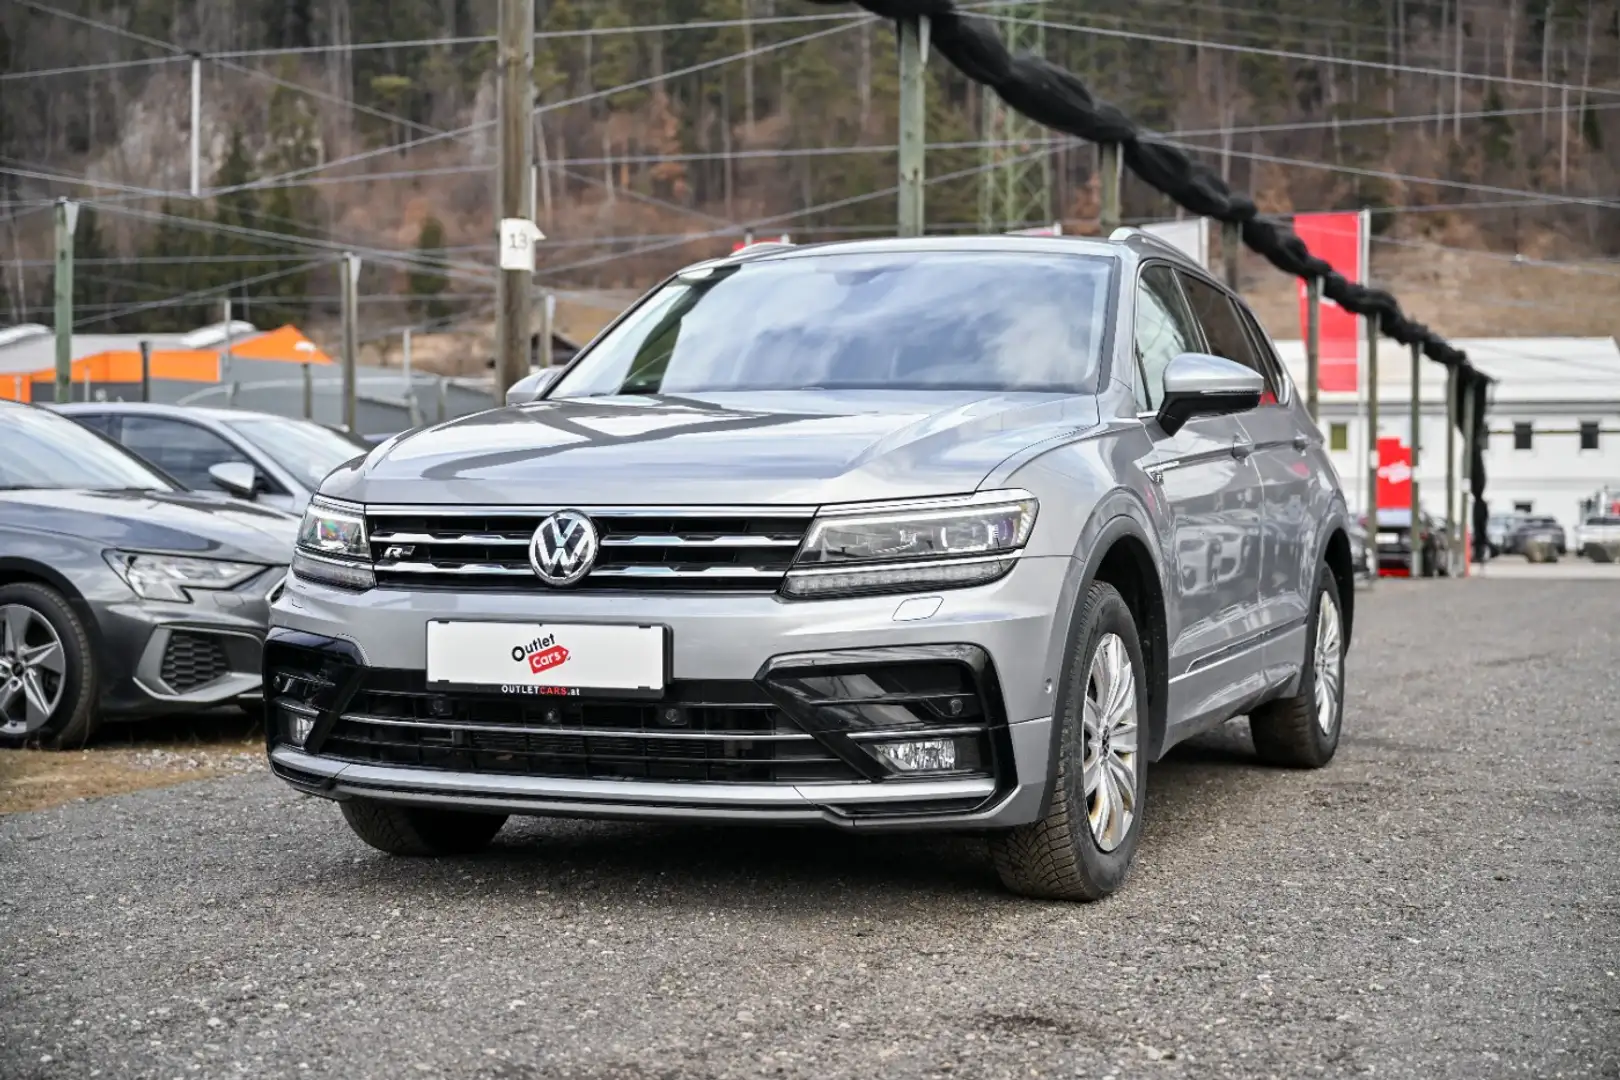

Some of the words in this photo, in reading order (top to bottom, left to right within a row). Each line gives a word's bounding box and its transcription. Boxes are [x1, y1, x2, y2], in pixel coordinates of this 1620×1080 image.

[509, 232, 529, 250] 13
[511, 633, 555, 662] Outlet
[532, 651, 562, 668] Cars
[501, 685, 580, 696] OUTLETCARS.at
